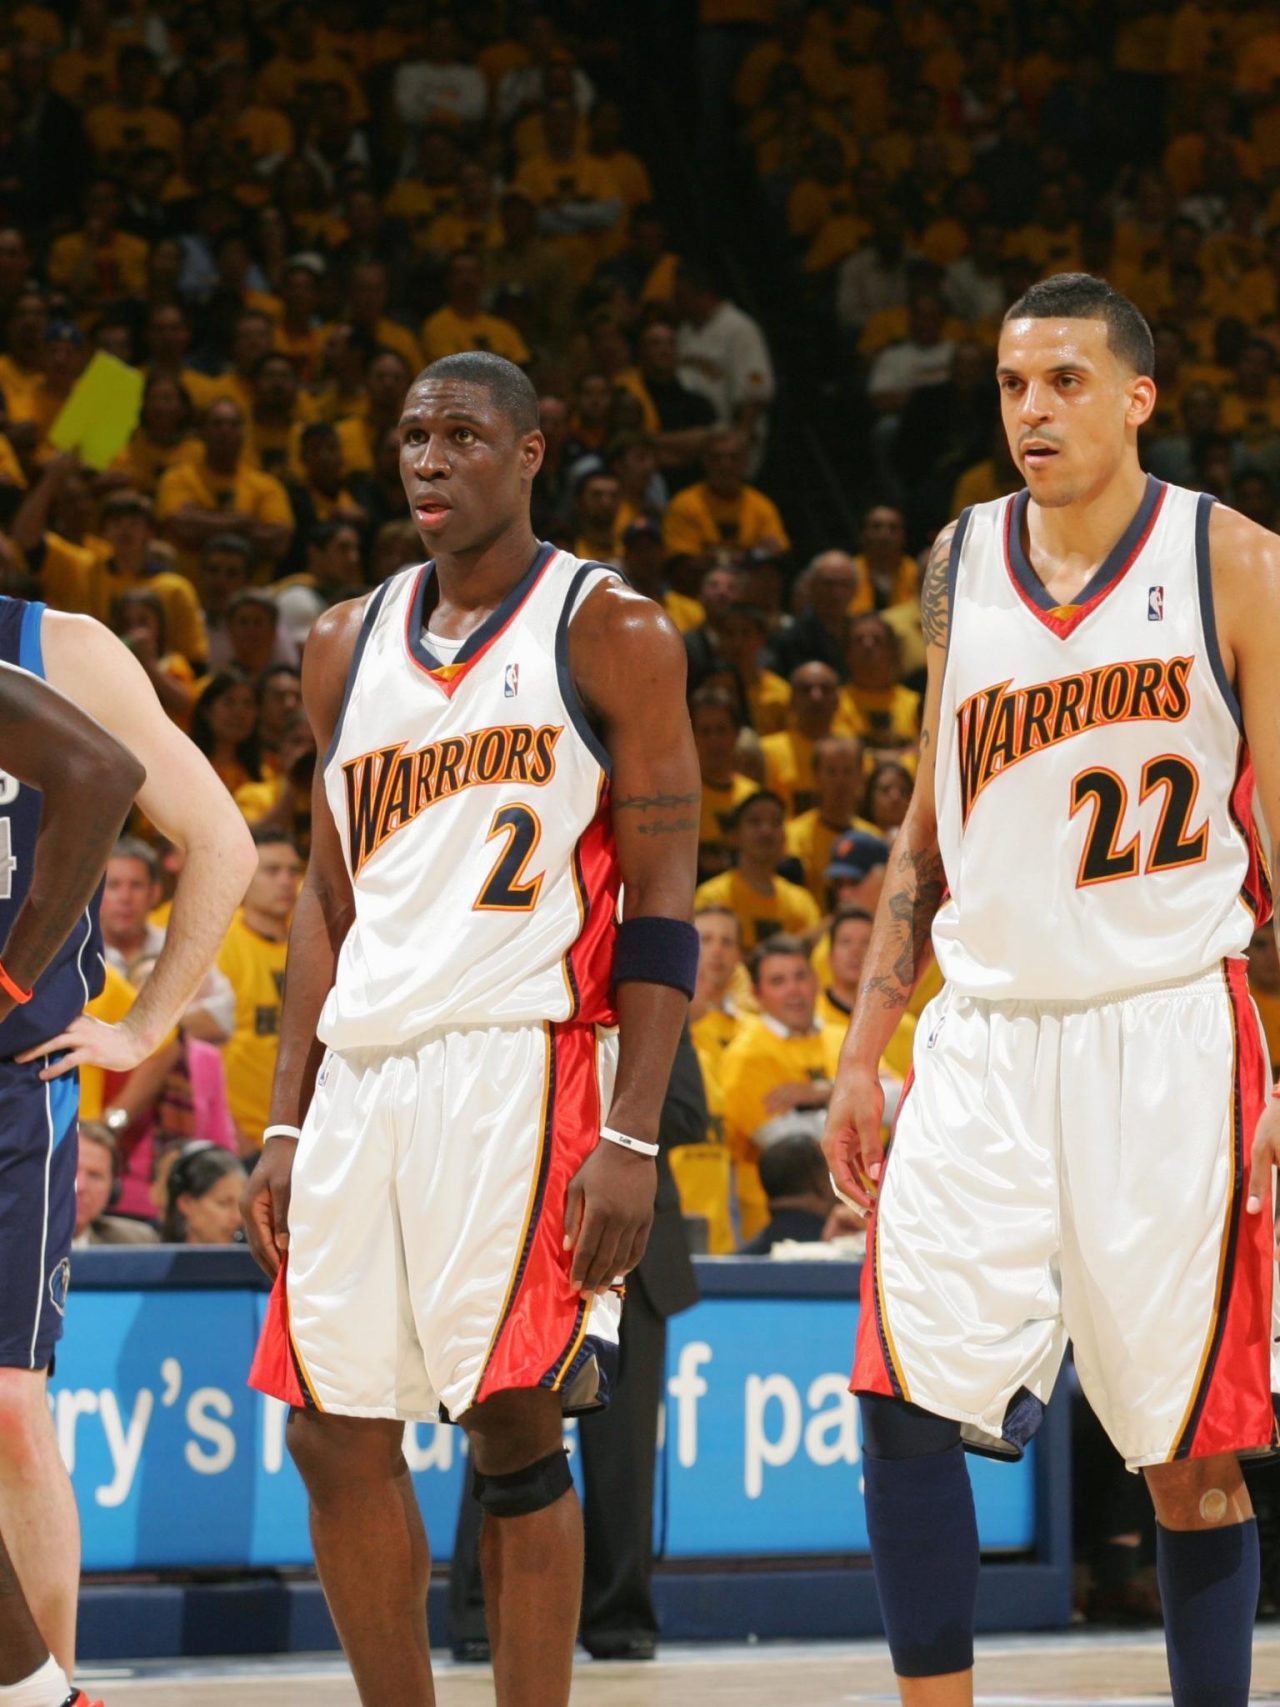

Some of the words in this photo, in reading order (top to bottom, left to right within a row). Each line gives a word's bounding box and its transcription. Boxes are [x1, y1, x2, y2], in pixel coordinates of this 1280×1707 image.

[341, 724, 565, 886] WARRIORS
[954, 655, 1195, 840] WARRIORS
[1069, 753, 1210, 889] 22
[472, 802, 546, 911] 2
[48, 1357, 237, 1507] ry's
[656, 1340, 713, 1469] f
[744, 1372, 865, 1500] pa
